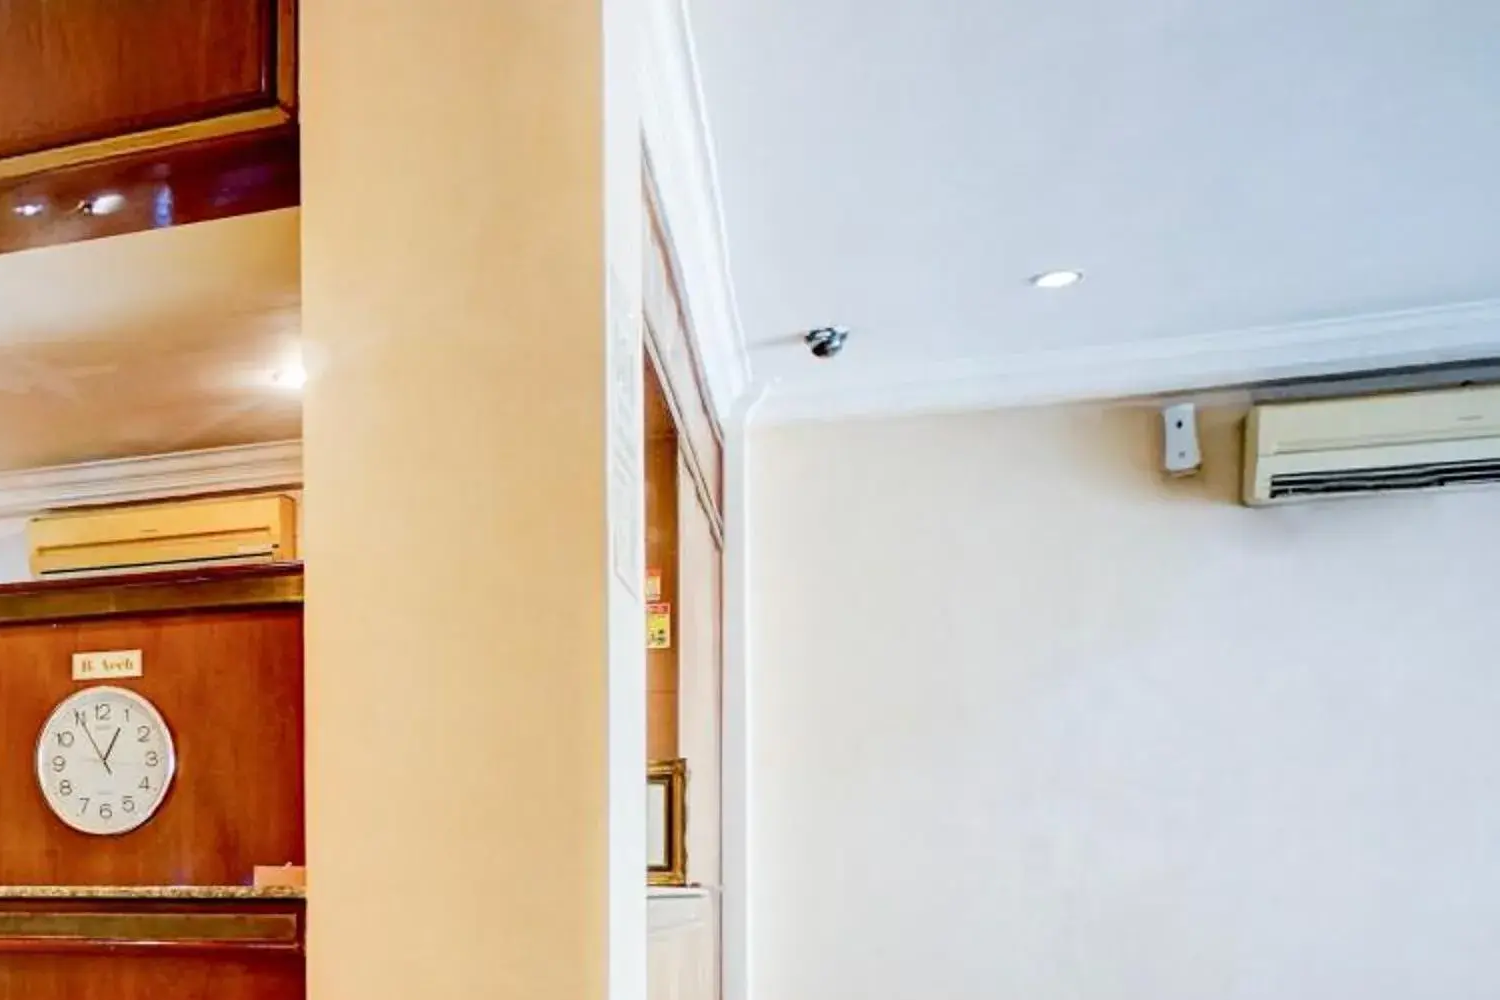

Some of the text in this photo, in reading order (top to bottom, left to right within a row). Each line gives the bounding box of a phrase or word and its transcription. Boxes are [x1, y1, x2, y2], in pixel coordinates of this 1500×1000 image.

[95, 703, 111, 720] 12
[57, 731, 75, 748] 10
[137, 725, 150, 743] 2
[52, 755, 66, 772] 9
[145, 751, 159, 767] 3
[59, 779, 72, 795] 8
[138, 776, 150, 790] 4
[79, 797, 90, 814] 7
[99, 803, 113, 819] 6
[122, 795, 135, 812] 5
